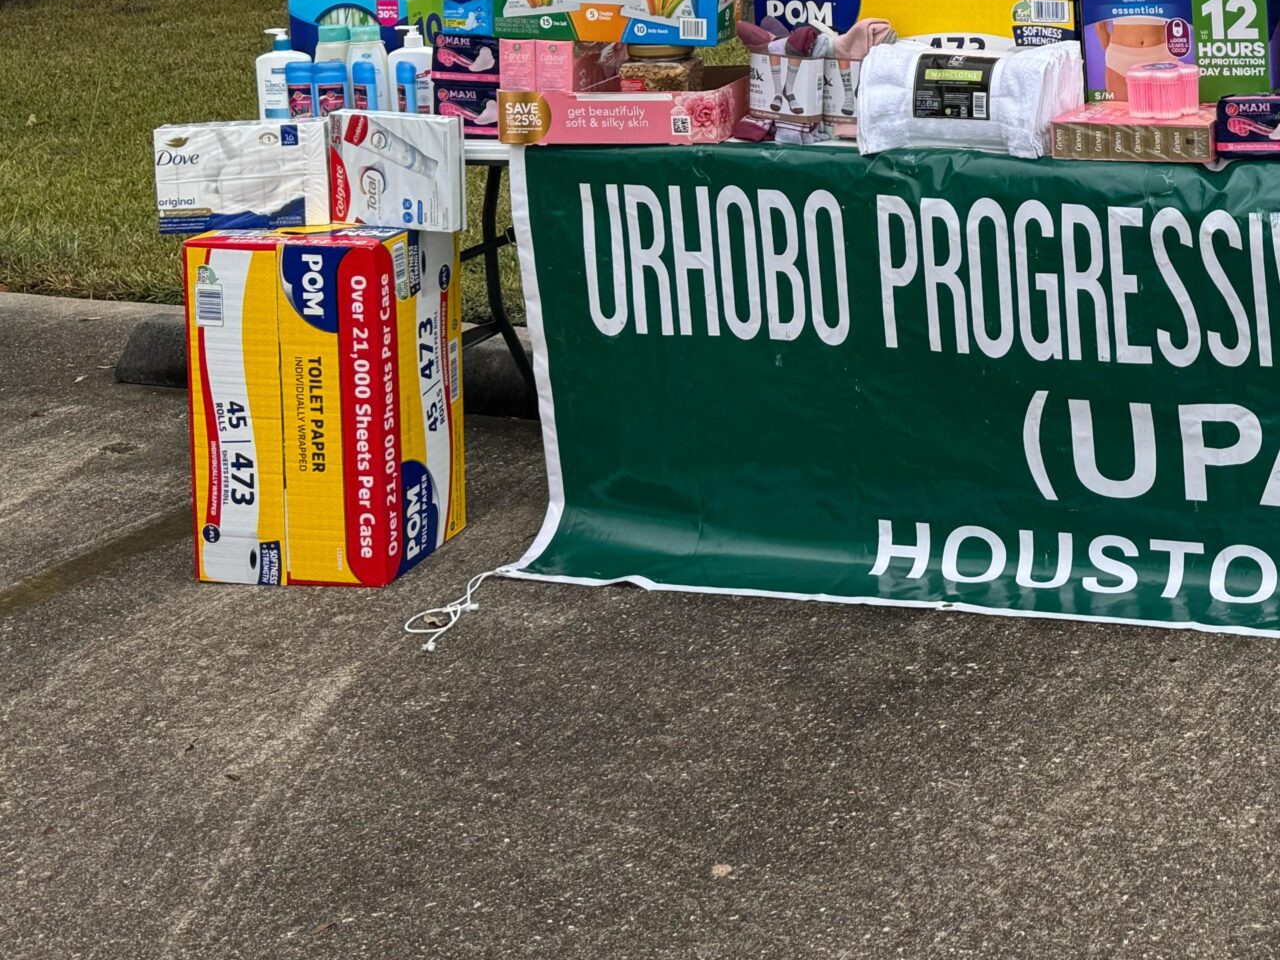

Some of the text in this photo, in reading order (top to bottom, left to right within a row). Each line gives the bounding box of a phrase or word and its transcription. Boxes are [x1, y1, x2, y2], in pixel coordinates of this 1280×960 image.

[1198, 42, 1265, 57] HOURS
[1095, 92, 1114, 100] S/M
[506, 102, 538, 115] SAVE
[567, 106, 645, 119] get beautifully
[1239, 103, 1271, 116] MAXI
[515, 115, 542, 126] 25%
[565, 118, 649, 130] soft & silky skin
[156, 150, 200, 166] Dove
[335, 163, 351, 218] Colgate
[367, 175, 378, 211] Total
[158, 198, 196, 208] original
[580, 184, 850, 345] URHOBO
[301, 254, 325, 316] POM
[308, 356, 326, 473] TOILET PAPER
[350, 275, 375, 559] Over 21,000 Sheets Per Case
[227, 401, 254, 506] 45 473
